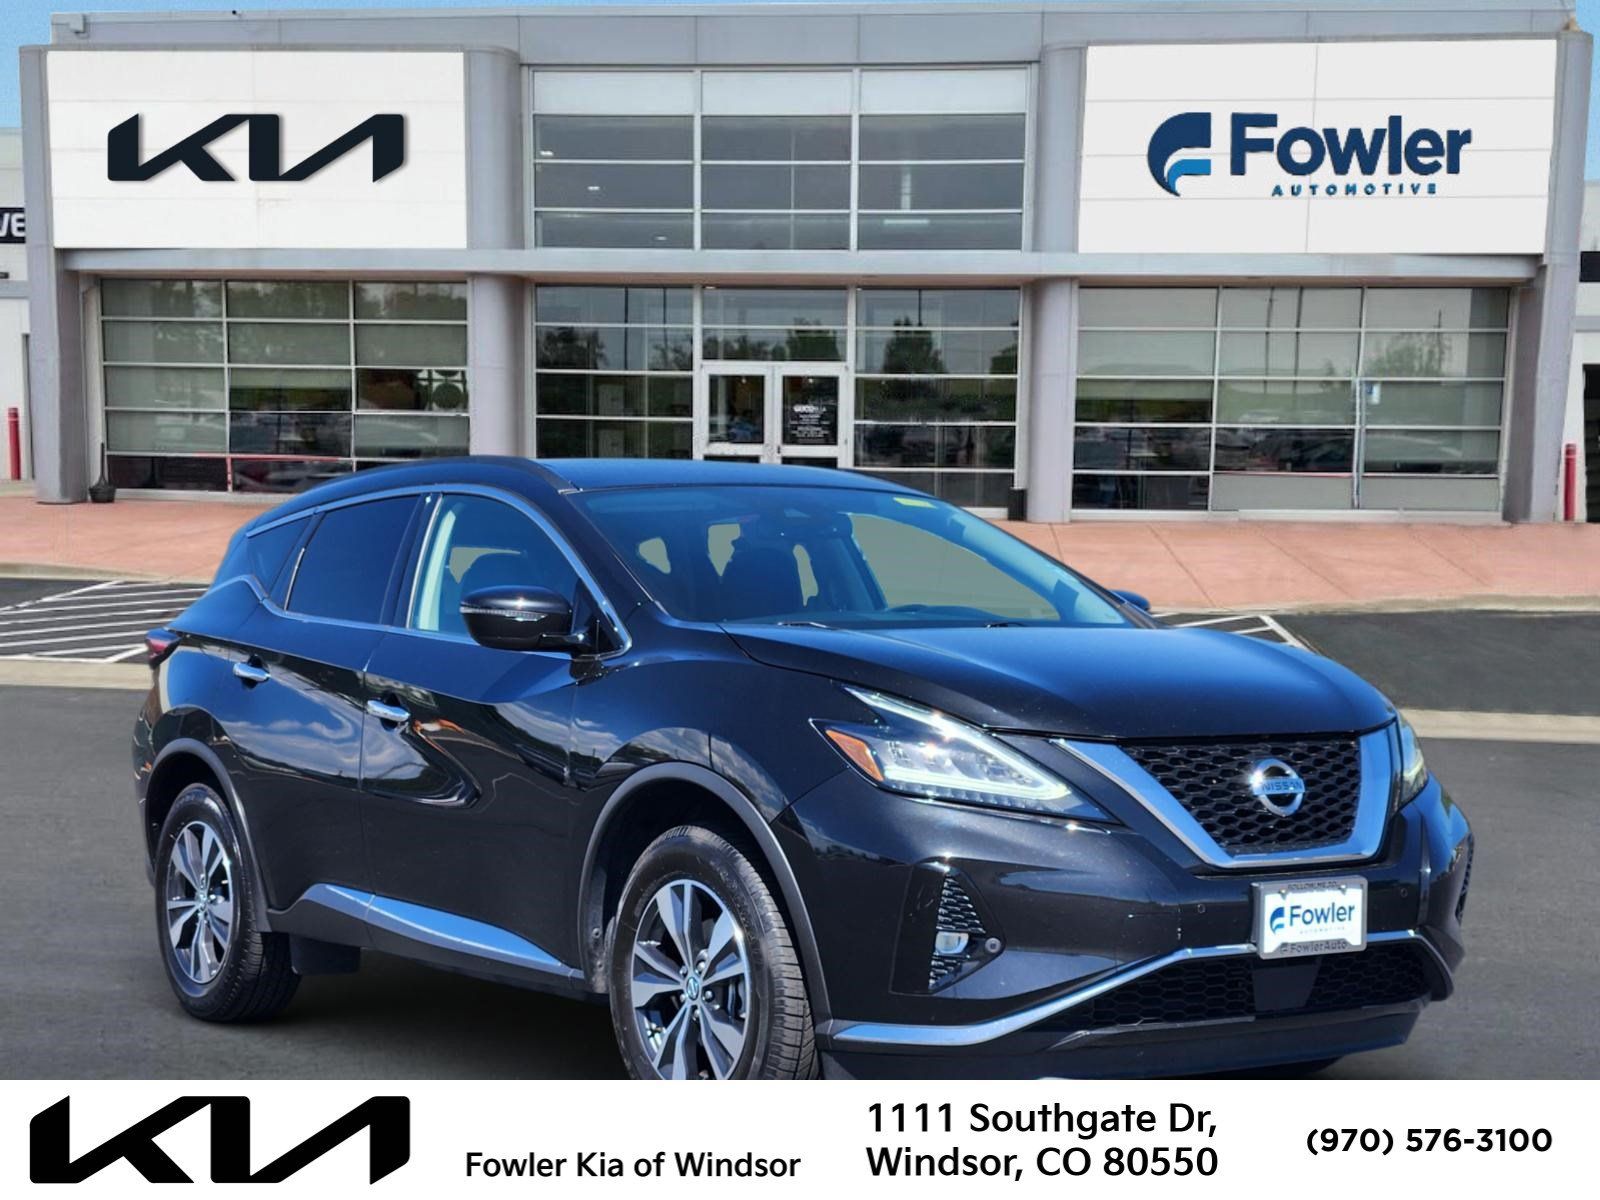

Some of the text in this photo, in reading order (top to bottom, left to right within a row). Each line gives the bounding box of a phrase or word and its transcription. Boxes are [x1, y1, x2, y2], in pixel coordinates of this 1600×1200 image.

[1230, 112, 1472, 177] Fowler
[1271, 182, 1437, 196] AUTOMOTIVE
[1289, 902, 1355, 926] Fowler
